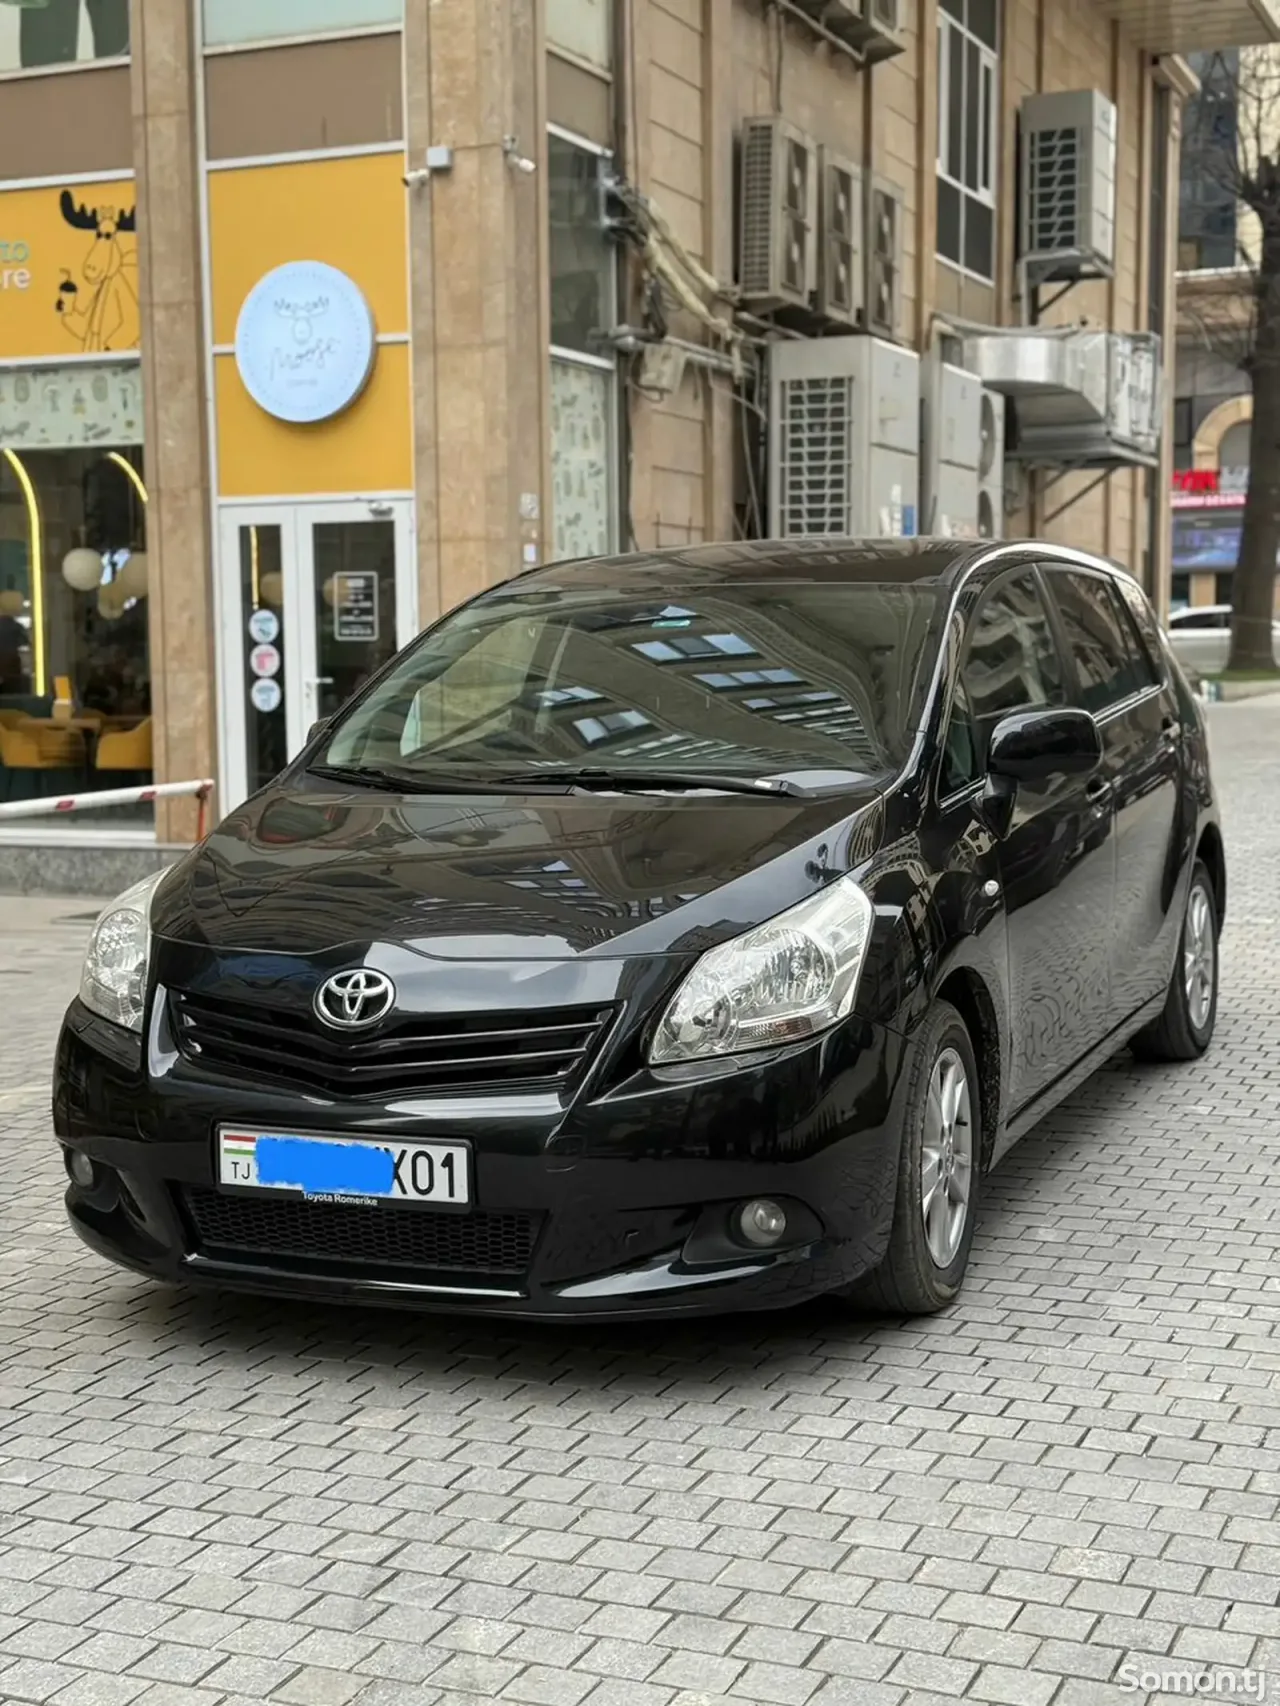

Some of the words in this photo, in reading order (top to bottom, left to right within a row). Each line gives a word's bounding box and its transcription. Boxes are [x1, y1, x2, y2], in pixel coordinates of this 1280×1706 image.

[0, 268, 31, 289] re
[231, 1161, 251, 1180] TJ
[301, 1190, 333, 1203] Toyota
[334, 1193, 378, 1206] Romerike
